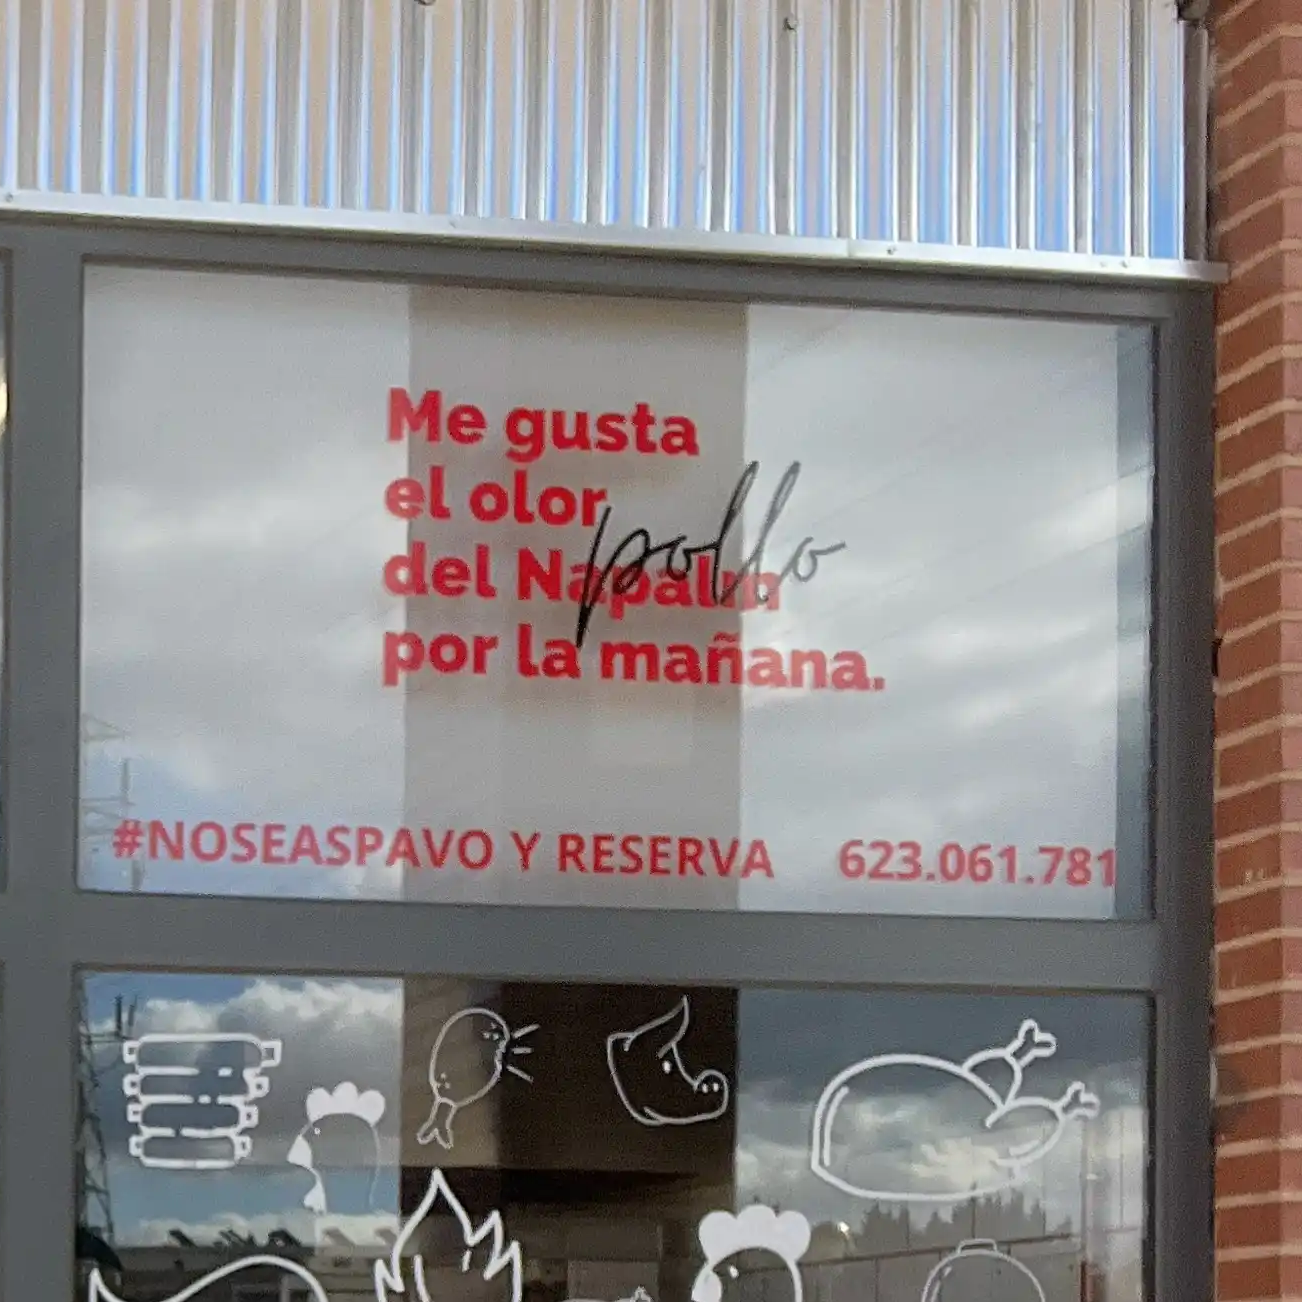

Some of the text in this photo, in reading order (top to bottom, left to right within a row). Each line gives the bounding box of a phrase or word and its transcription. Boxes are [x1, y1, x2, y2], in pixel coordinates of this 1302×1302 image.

[387, 386, 700, 463] Me gusta
[383, 464, 608, 528] el olor
[383, 541, 781, 620] del Napalm
[575, 460, 846, 648] pollo
[382, 623, 888, 693] por la mañana.
[113, 818, 1118, 887] #NOSEASPAVO Y RESERVA 623.061.781
